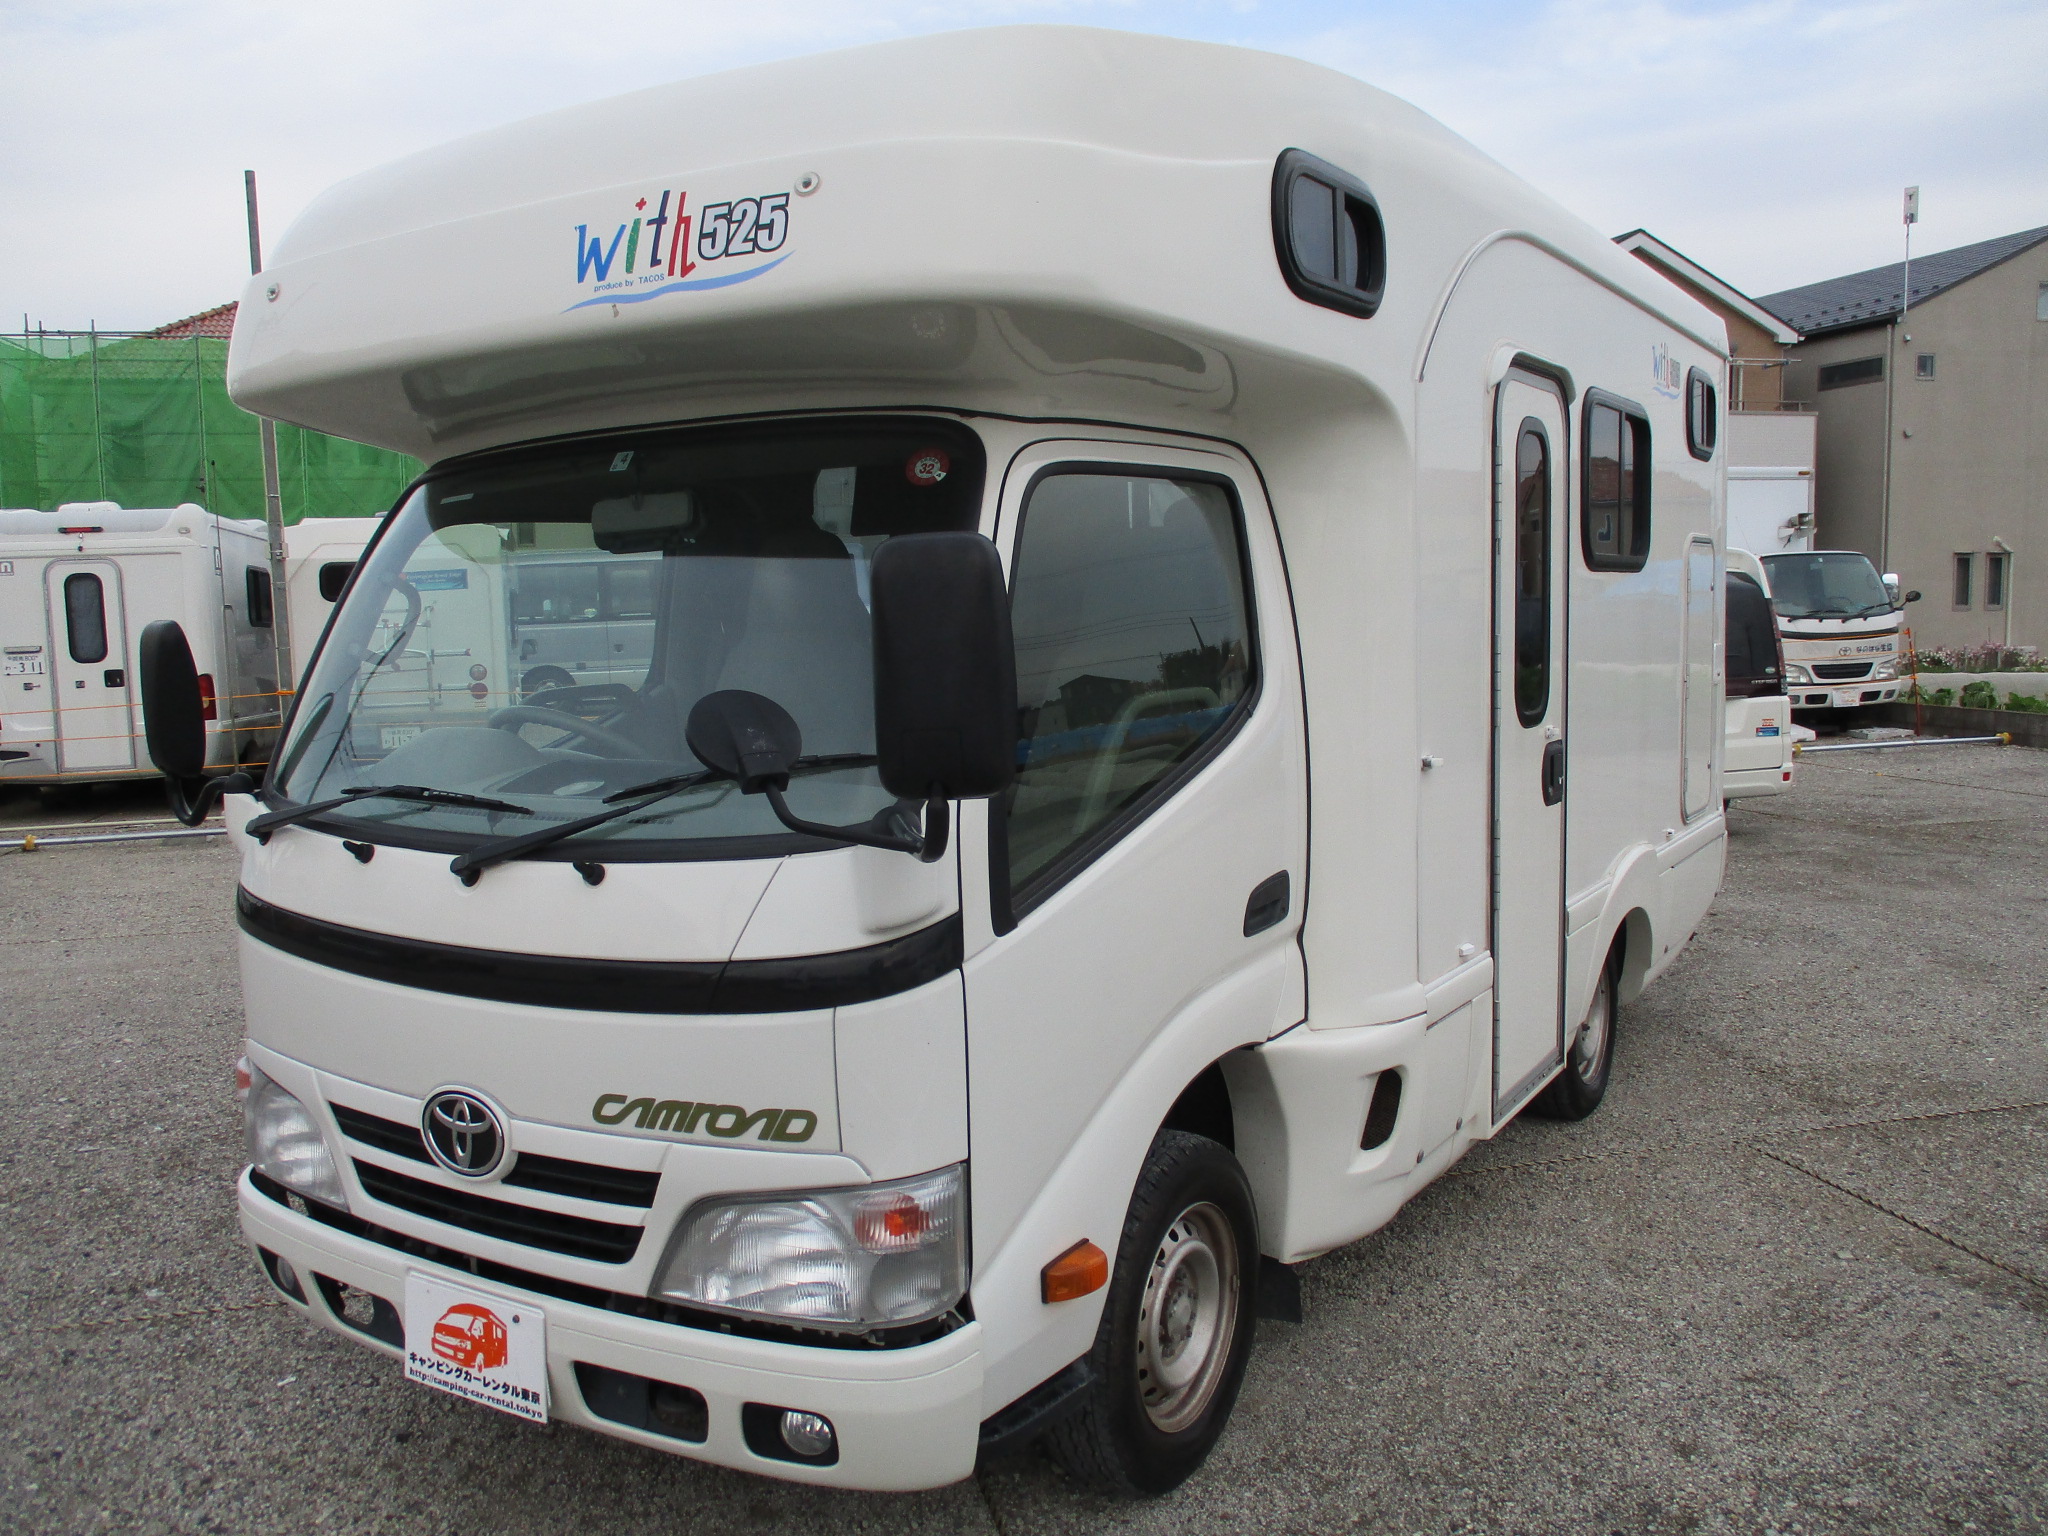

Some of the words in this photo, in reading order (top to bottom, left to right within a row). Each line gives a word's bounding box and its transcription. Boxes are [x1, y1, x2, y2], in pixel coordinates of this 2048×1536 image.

[697, 192, 790, 261] 525
[594, 281, 623, 292] produce
[624, 279, 634, 287] by
[638, 273, 665, 284] TACOS
[919, 463, 935, 475] 32
[592, 1093, 818, 1143] CAMROAD
[409, 1367, 543, 1419] http://camping-car-rental.tokyo
